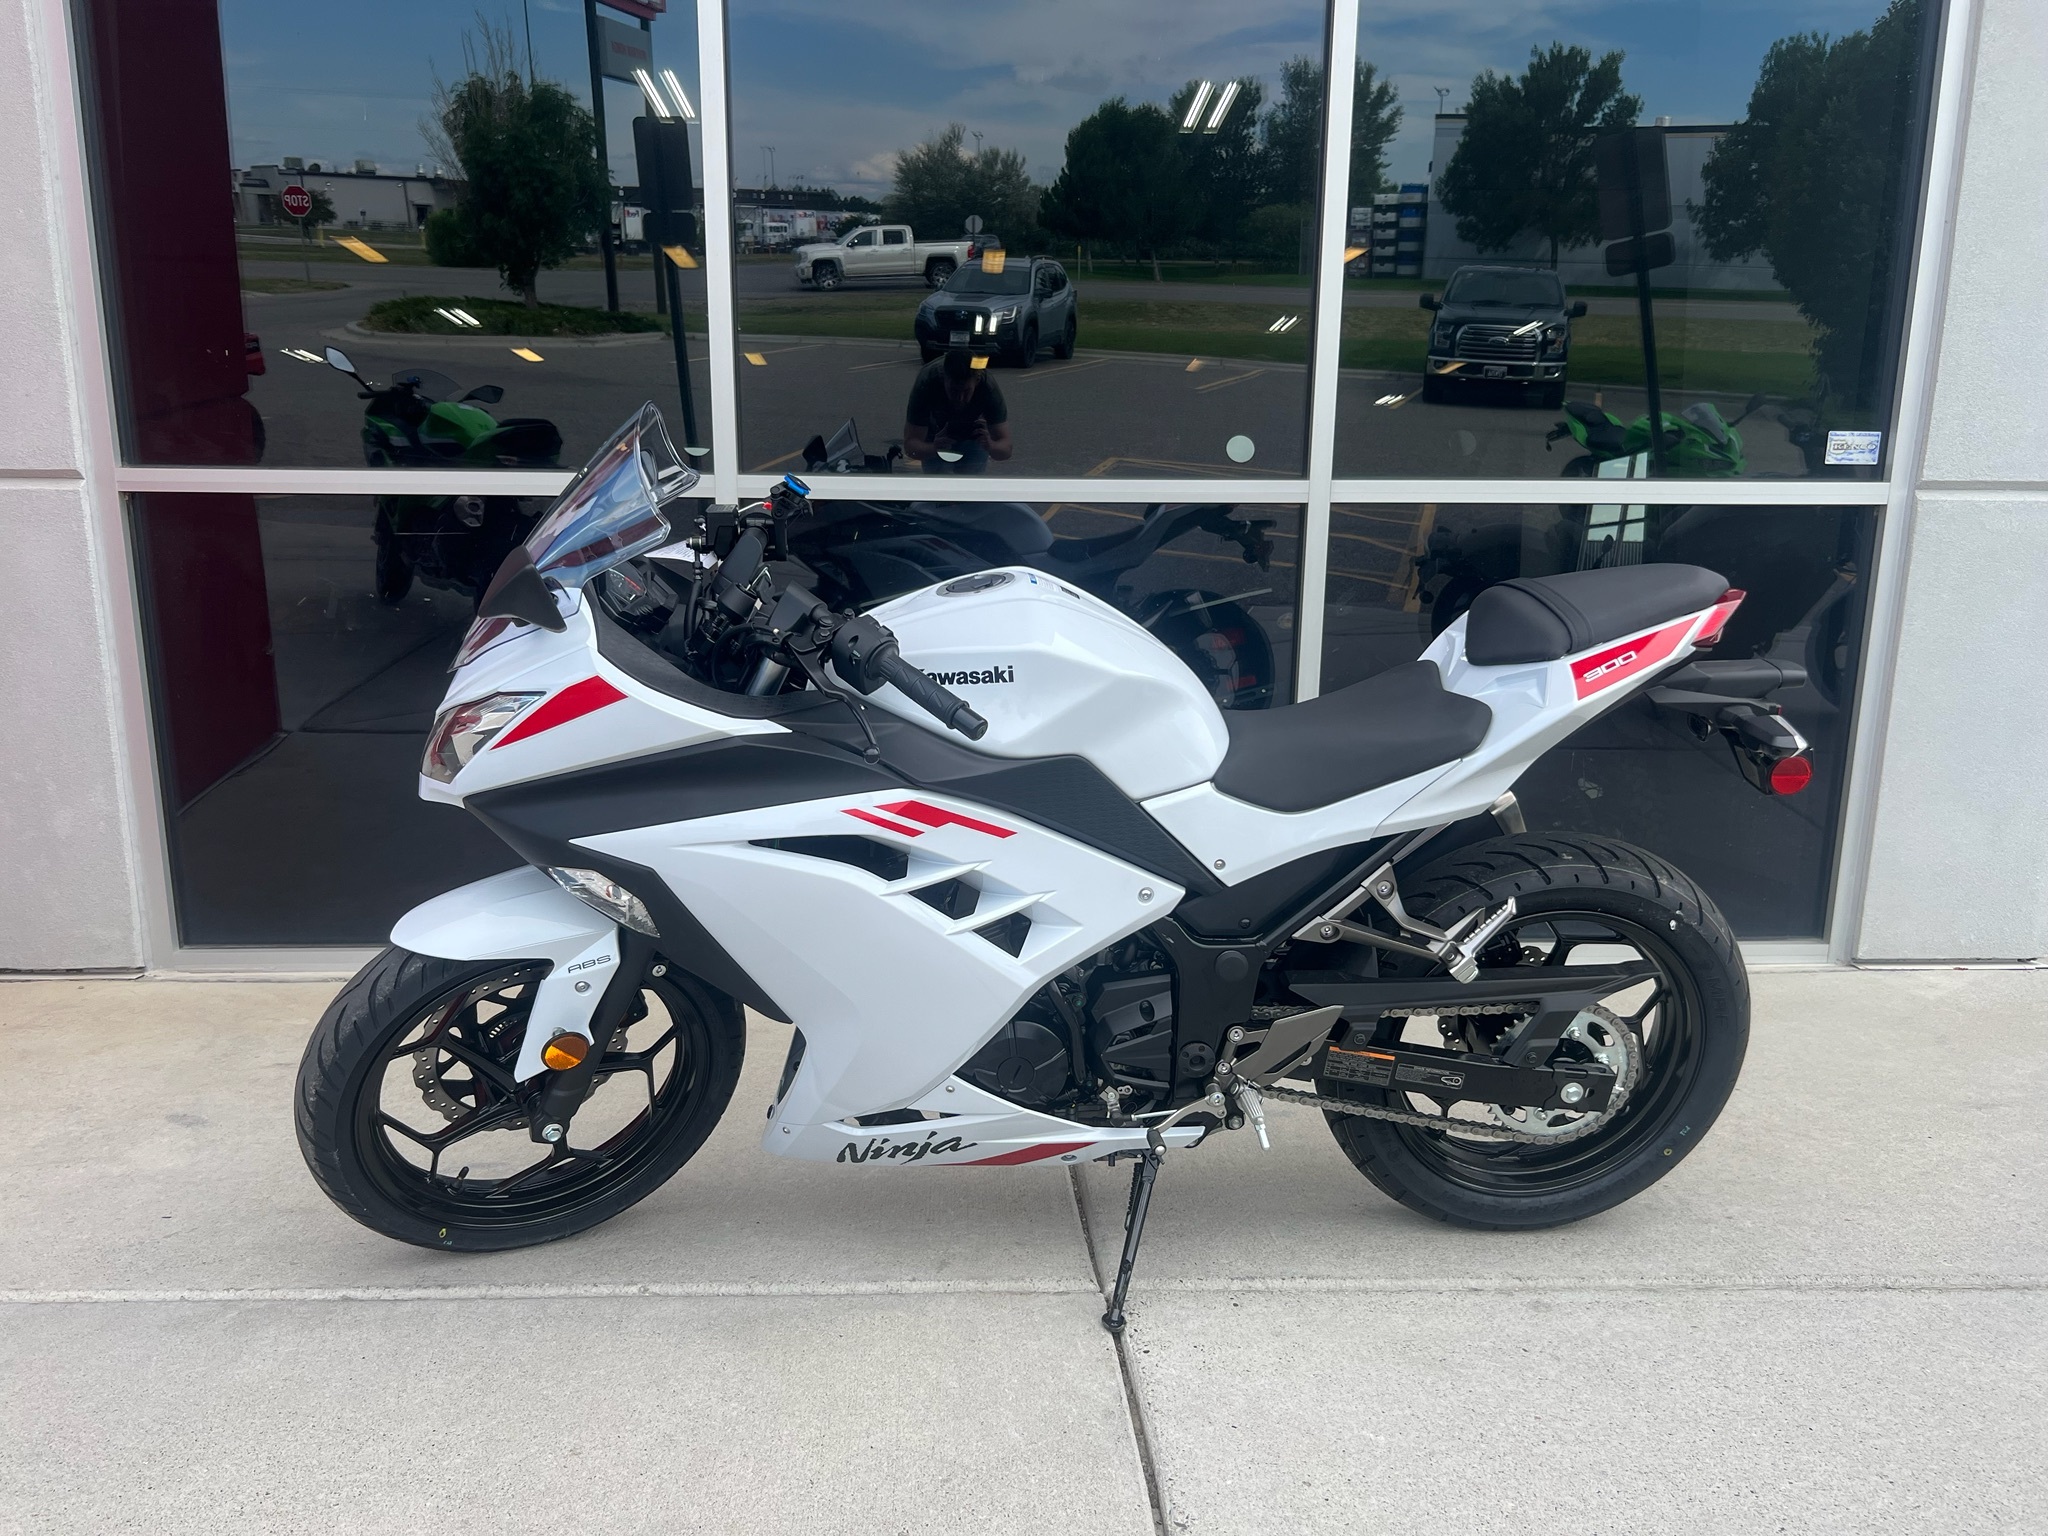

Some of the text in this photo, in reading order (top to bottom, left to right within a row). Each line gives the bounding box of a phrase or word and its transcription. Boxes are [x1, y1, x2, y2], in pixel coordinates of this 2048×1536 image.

[918, 665, 1014, 685] awasaki
[1583, 650, 1637, 683] 300
[567, 954, 611, 973] ABS
[836, 1131, 978, 1165] Ninja
